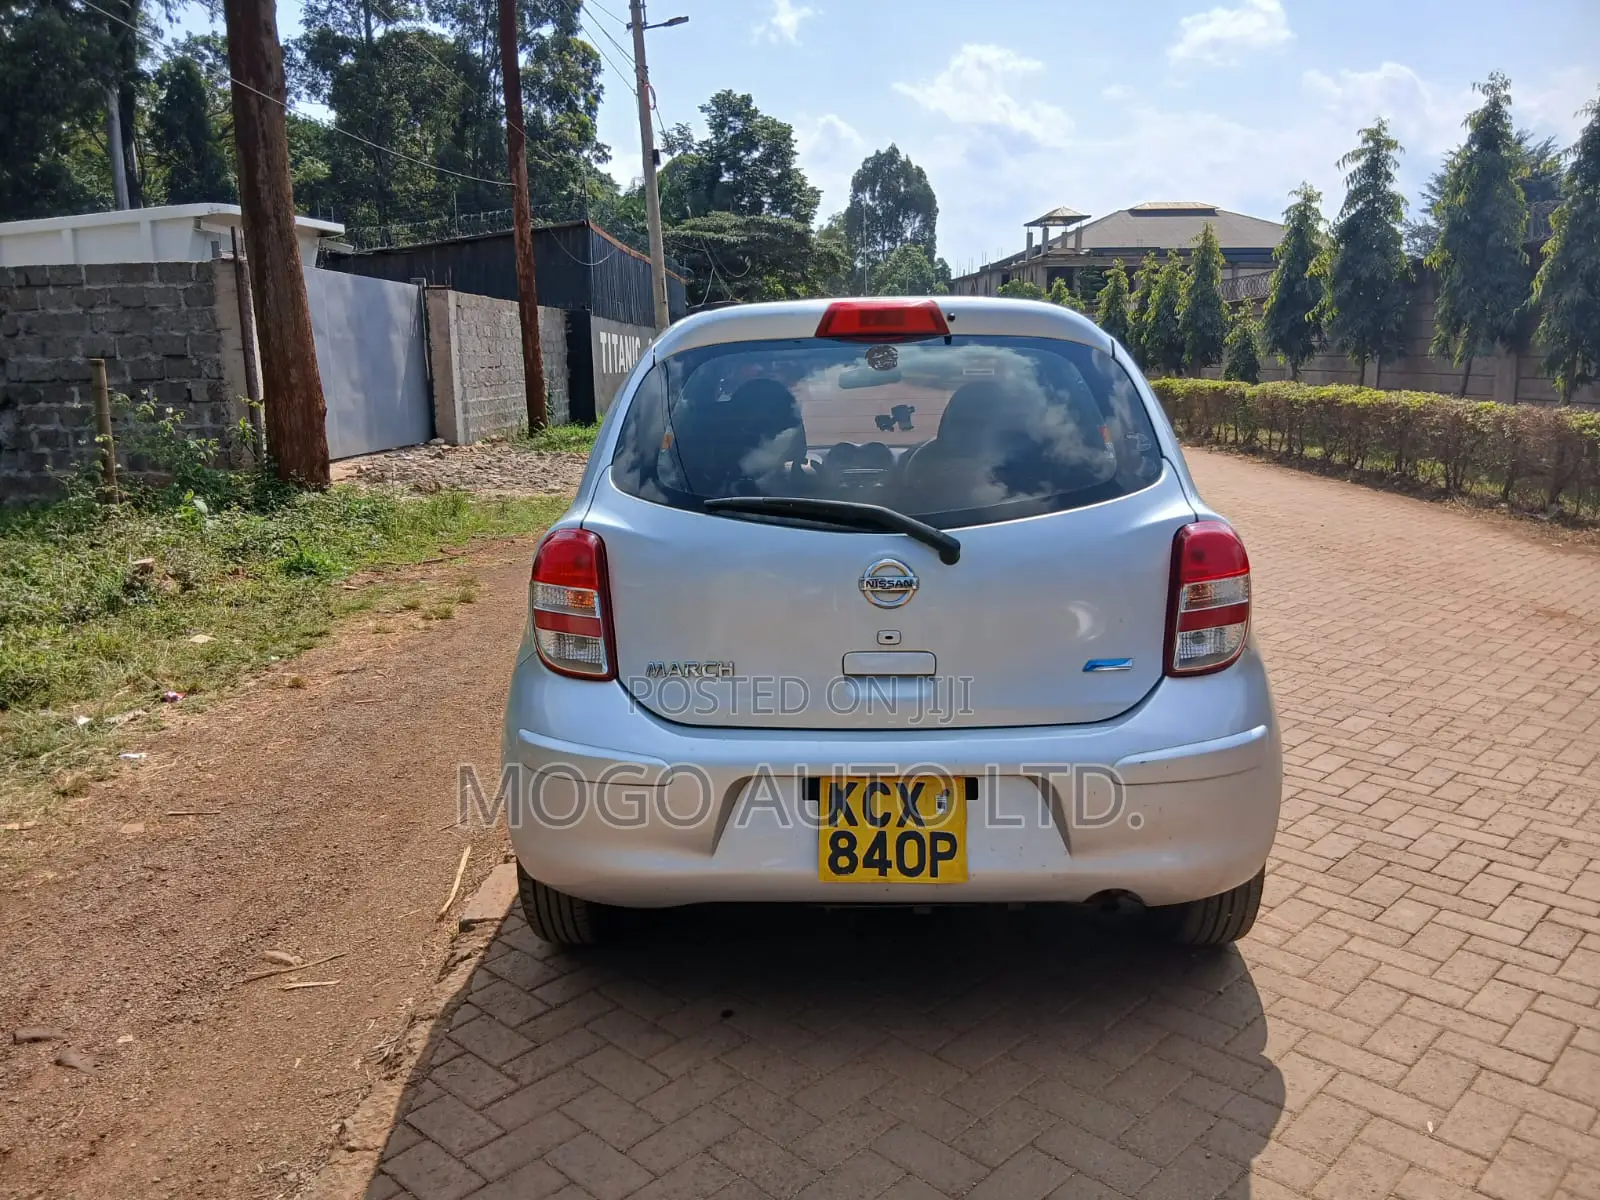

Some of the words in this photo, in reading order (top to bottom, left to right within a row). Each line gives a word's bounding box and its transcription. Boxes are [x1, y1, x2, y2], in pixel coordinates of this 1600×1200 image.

[865, 579, 913, 589] NISSAN
[646, 660, 735, 677] MARCH
[828, 781, 926, 828] KCX
[827, 830, 958, 878] 840P
